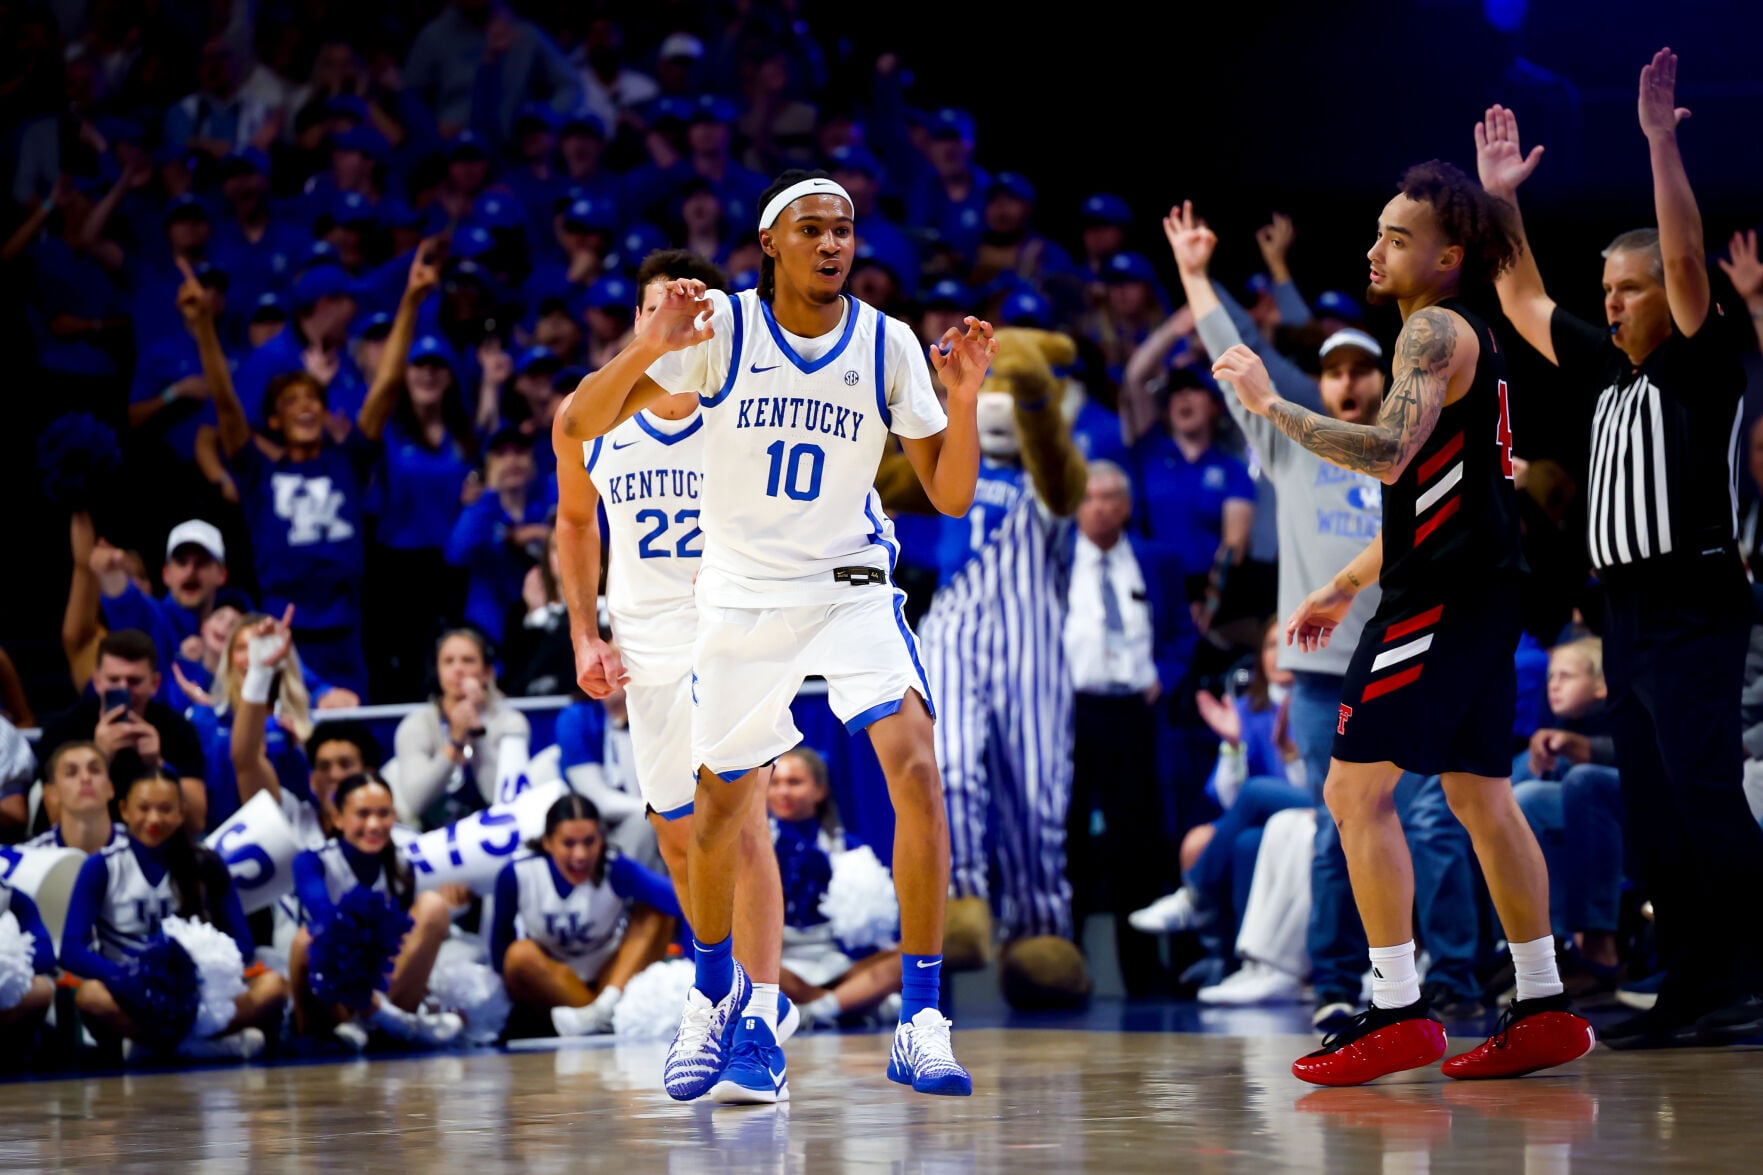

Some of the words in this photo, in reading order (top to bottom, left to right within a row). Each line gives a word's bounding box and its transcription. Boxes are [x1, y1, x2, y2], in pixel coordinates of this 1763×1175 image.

[736, 397, 864, 442] KENTUCKY
[609, 469, 704, 505] KENTUC
[766, 439, 826, 502] 10
[269, 471, 356, 547] UK
[635, 508, 704, 559] 22
